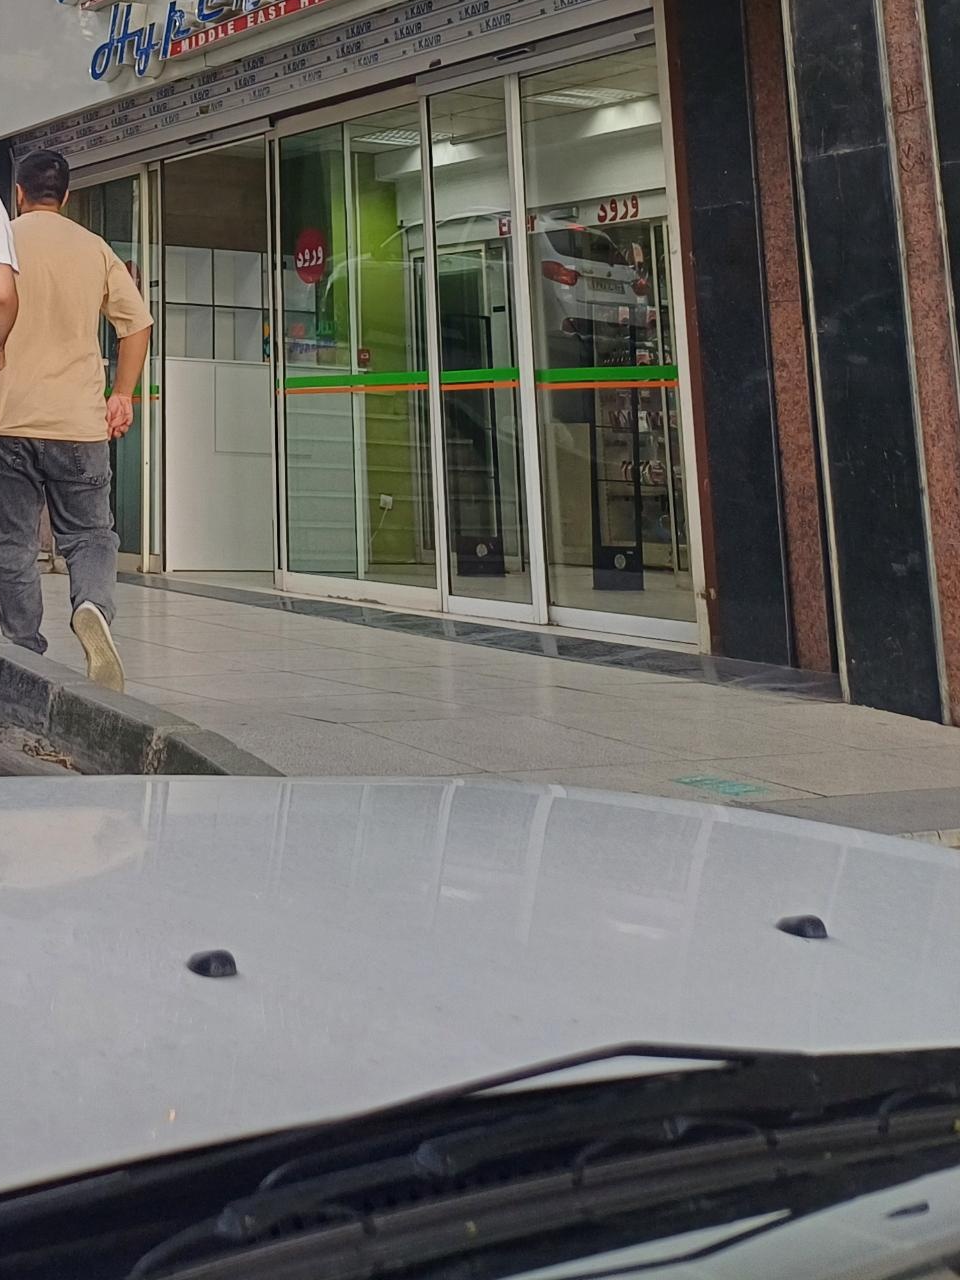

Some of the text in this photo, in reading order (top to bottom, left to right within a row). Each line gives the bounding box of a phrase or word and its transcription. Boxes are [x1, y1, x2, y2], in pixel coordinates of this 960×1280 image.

[181, 20, 235, 53] MIDDLE
[247, 0, 289, 30] EAST
[238, 74, 256, 88] KAVIR
[287, 58, 306, 72] KAVIR
[341, 39, 361, 55] KAVIR
[399, 22, 422, 37] KAVIR
[464, 0, 489, 17] KAVIR
[246, 56, 264, 70] KAVIR
[296, 39, 315, 53] KAVIR
[351, 20, 371, 35] KAVIR
[410, 0, 433, 16] KAVIR
[357, 53, 379, 67] KAVIR
[418, 34, 441, 50] KAVIR
[484, 13, 511, 30] KAVIR
[597, 194, 640, 224] ورود
[296, 244, 325, 269] ورود
